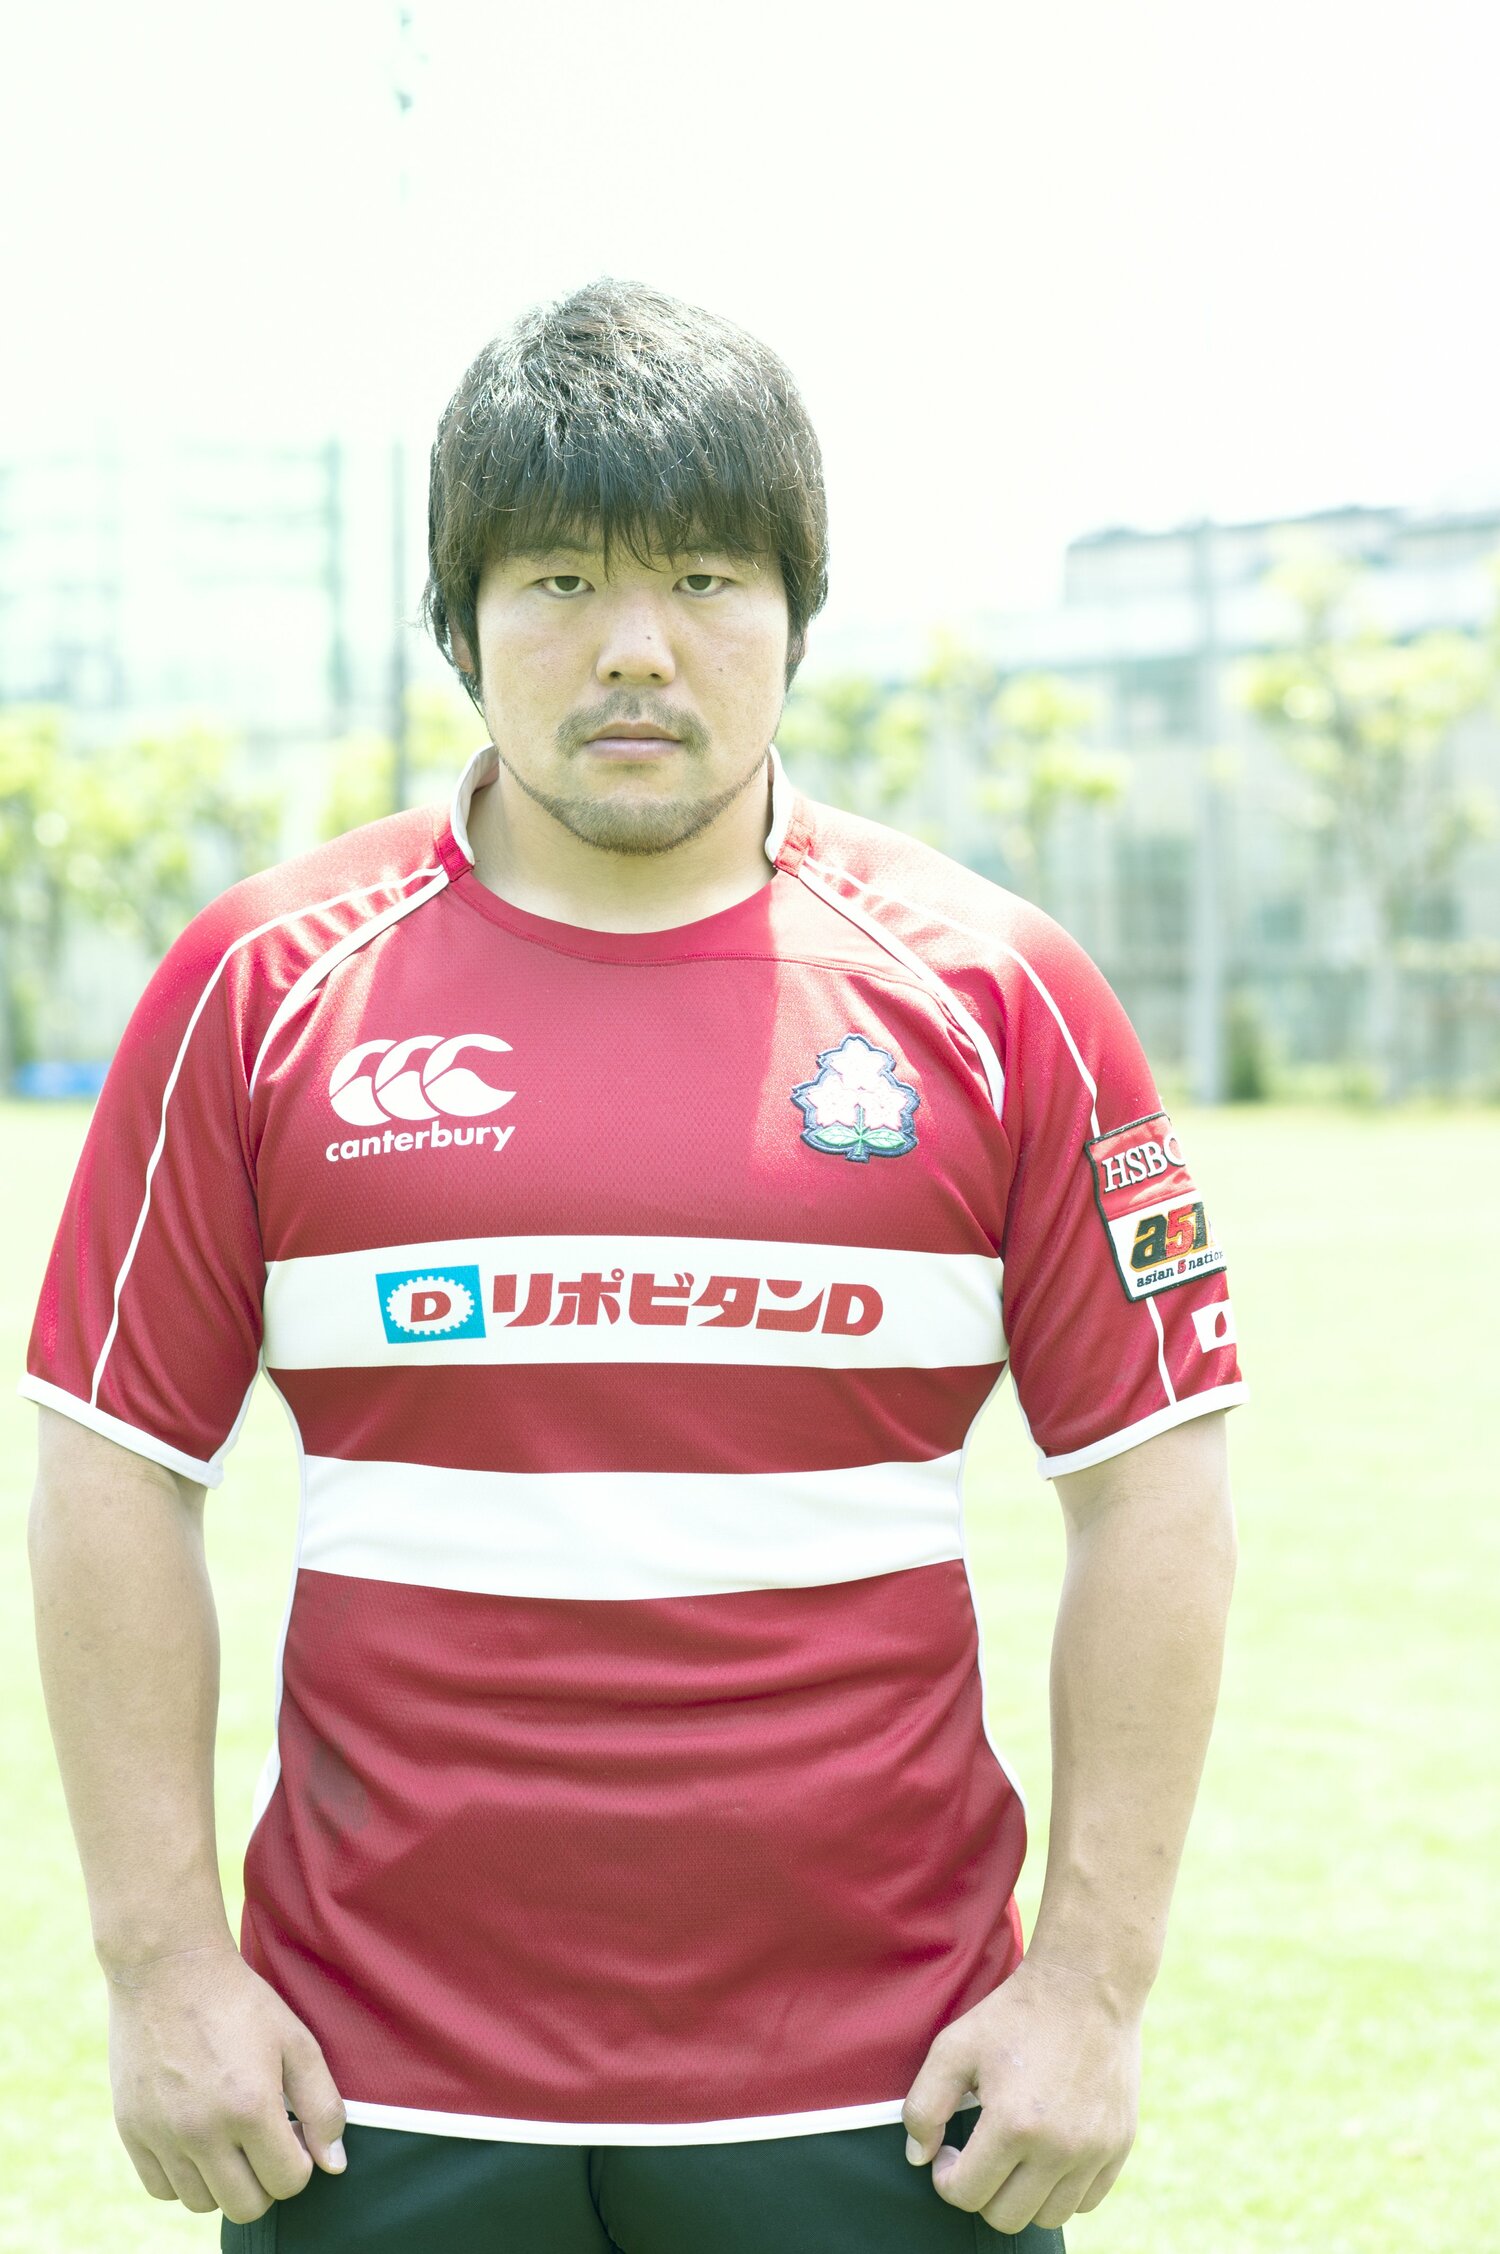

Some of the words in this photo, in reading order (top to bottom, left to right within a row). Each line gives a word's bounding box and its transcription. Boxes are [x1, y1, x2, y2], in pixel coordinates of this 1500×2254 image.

[326, 1120, 516, 1162] canterbury
[1136, 1267, 1174, 1288] asian
[1177, 1259, 1187, 1274] 5
[410, 1291, 452, 1323] D
[493, 1268, 884, 1337] リポビタンD
